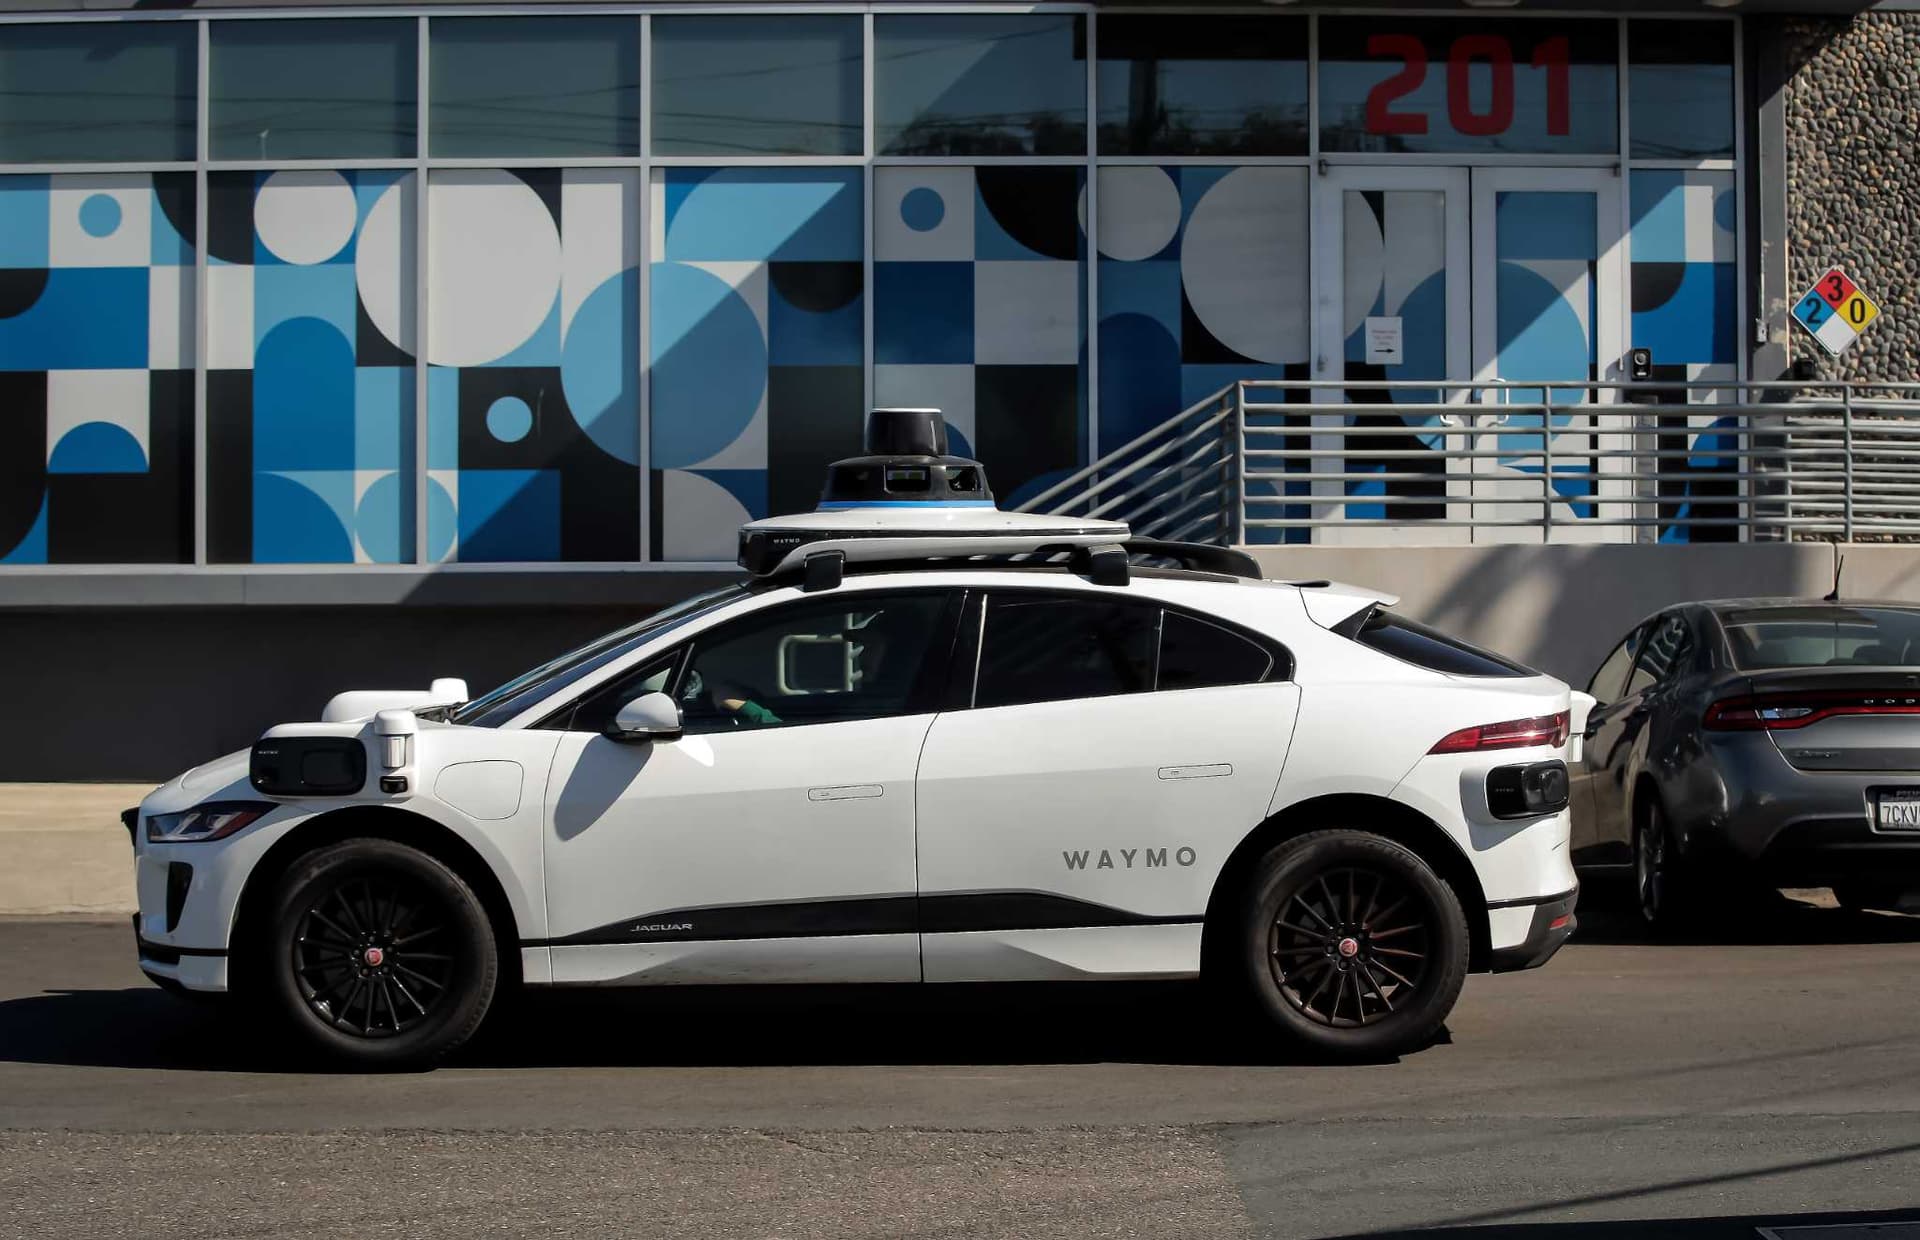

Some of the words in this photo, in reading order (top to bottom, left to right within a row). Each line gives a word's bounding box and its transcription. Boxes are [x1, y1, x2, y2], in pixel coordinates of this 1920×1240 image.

[1366, 34, 1570, 136] 201
[1827, 275, 1843, 302] 3
[1805, 297, 1822, 324] 2
[1849, 297, 1866, 324] 0
[1883, 805, 1920, 825] 7CKV
[1062, 846, 1197, 871] WAYMO
[630, 923, 693, 932] JAGUAR
